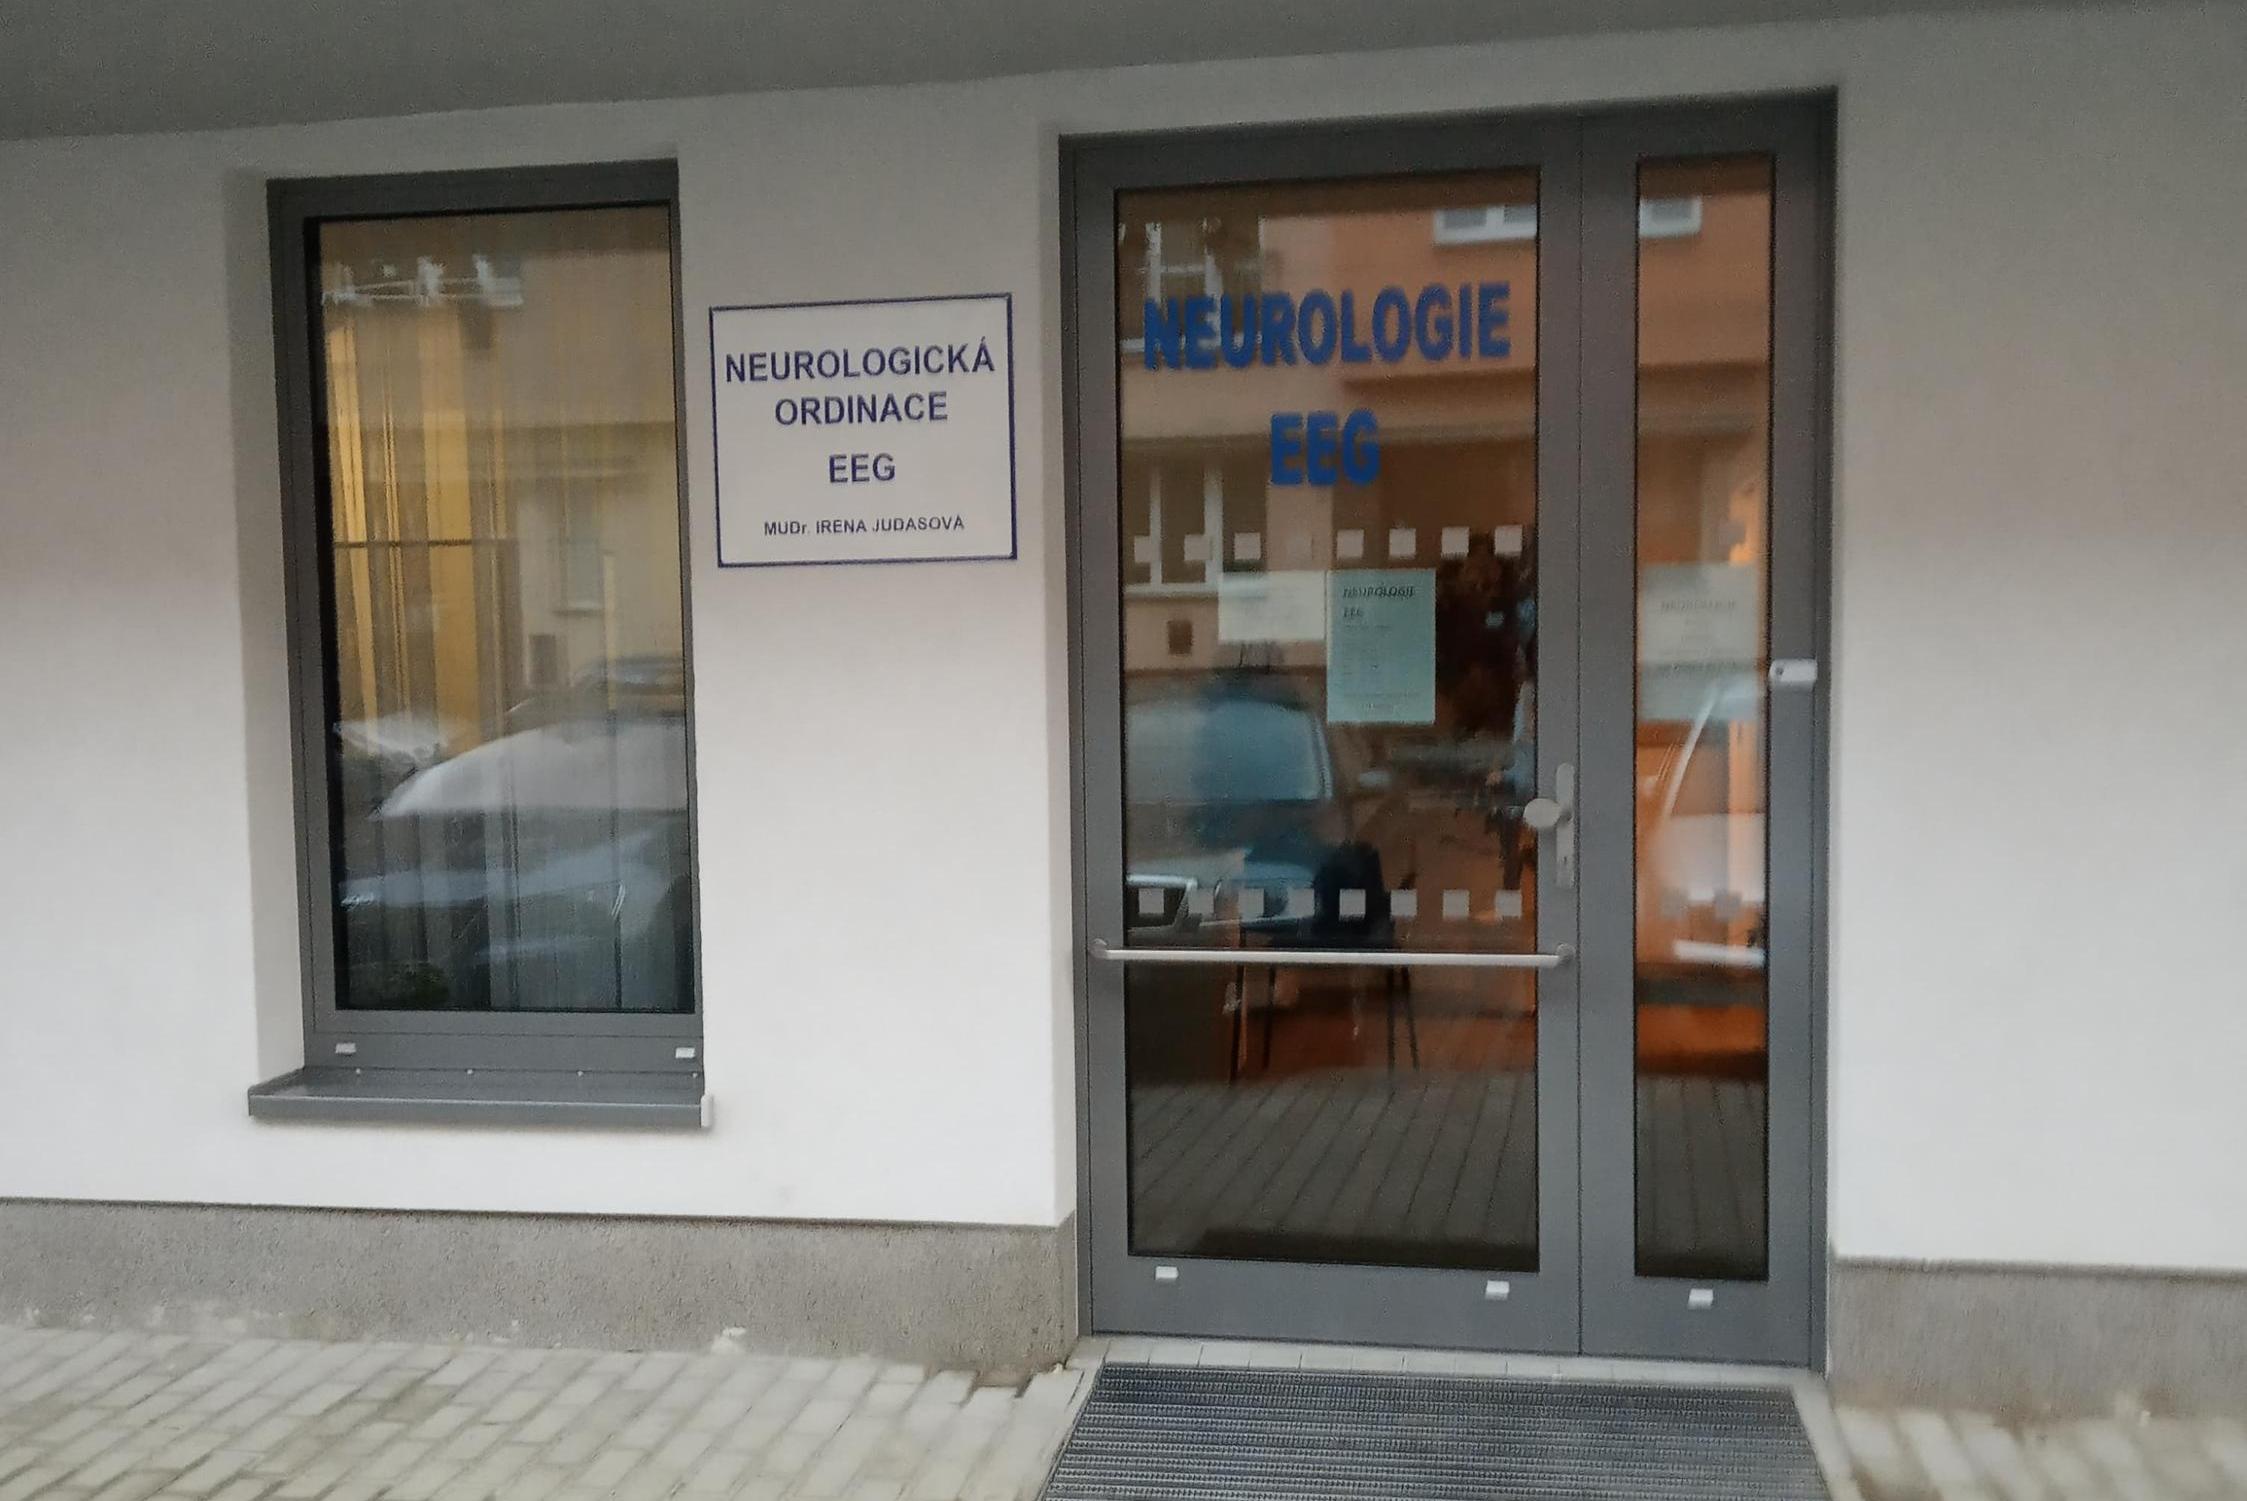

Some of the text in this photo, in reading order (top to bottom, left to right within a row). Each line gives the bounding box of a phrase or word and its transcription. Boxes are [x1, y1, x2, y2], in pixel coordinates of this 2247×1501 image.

[1144, 281, 1511, 370] NEUROLOGIE
[725, 337, 995, 382] NEUROLOGICKÁ
[775, 391, 948, 425] ORDINACE
[1270, 407, 1381, 486] EEG
[829, 453, 896, 483] EEG
[816, 518, 867, 534] IRENA
